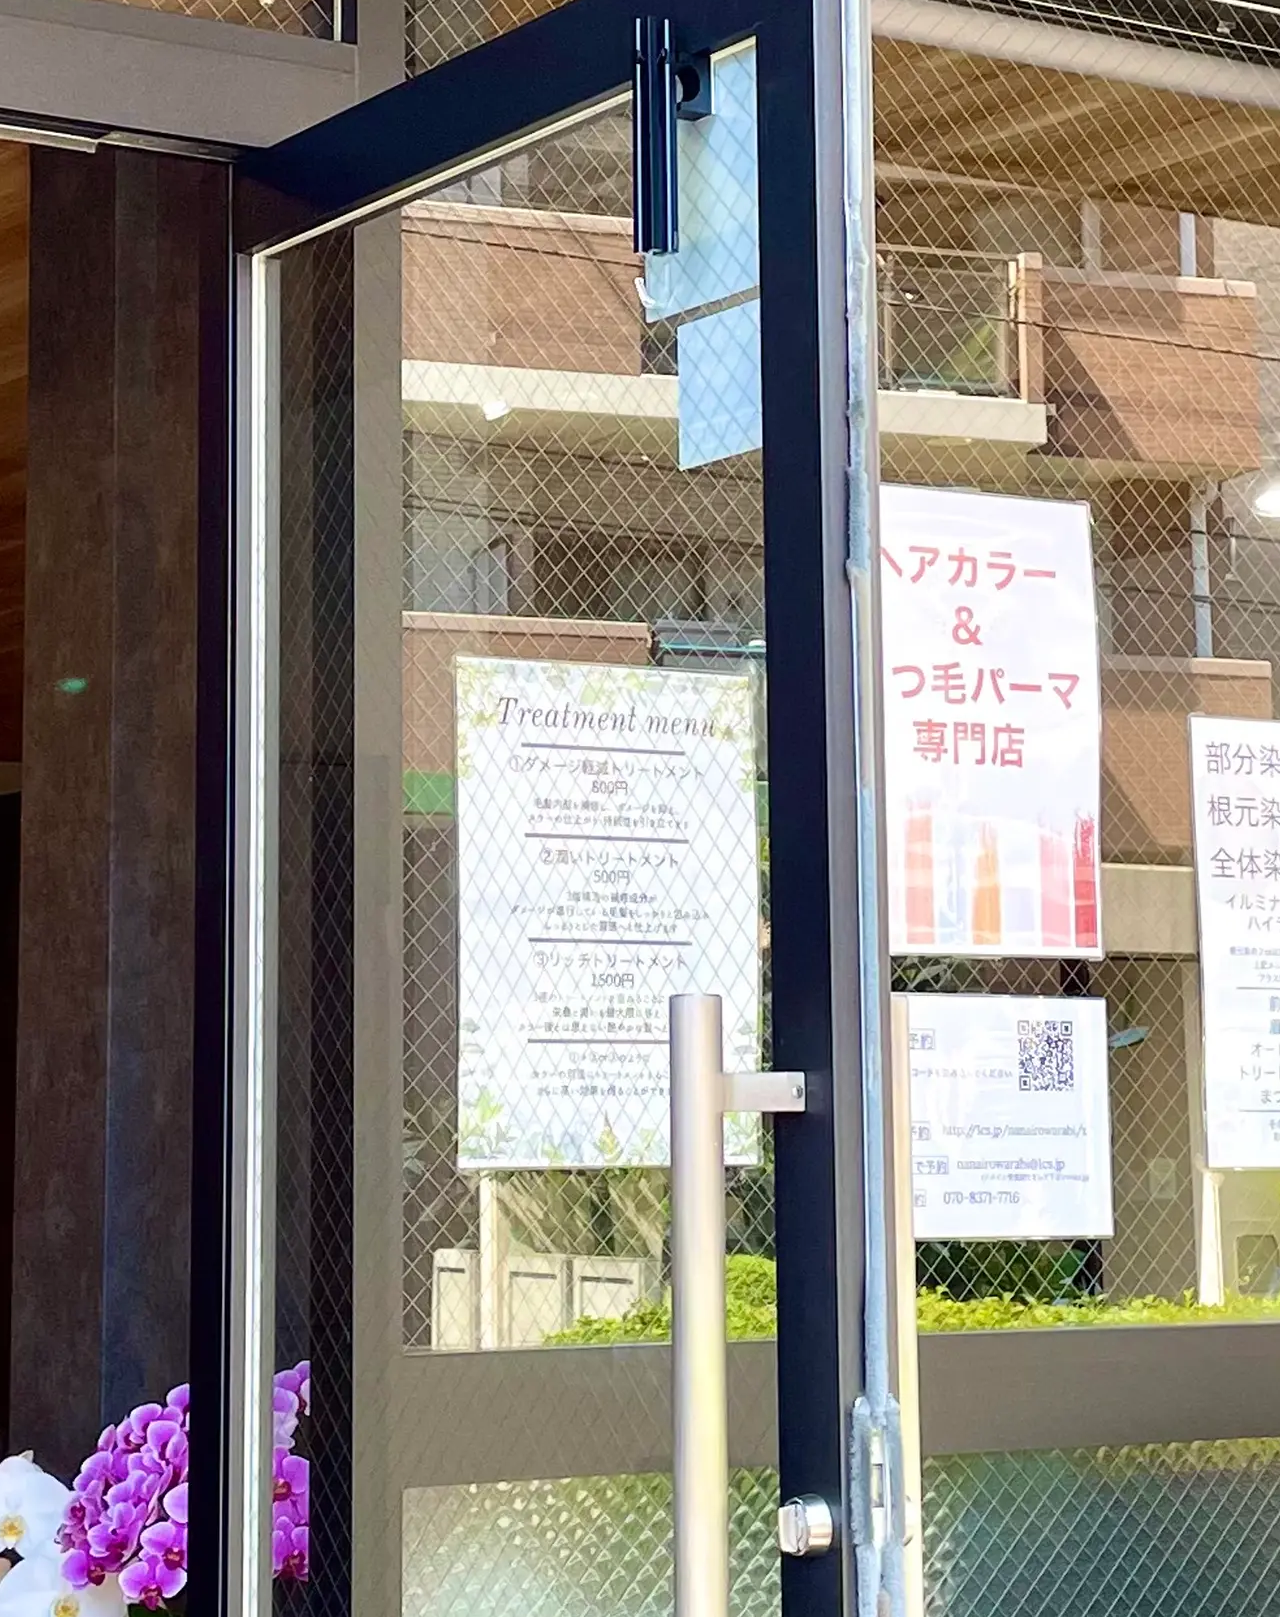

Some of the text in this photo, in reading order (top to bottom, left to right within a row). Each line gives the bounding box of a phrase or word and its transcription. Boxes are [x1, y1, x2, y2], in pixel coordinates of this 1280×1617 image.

[880, 545, 1056, 591] ヘアカラー
[952, 605, 983, 646] &
[892, 662, 1080, 710] つ毛パーマ
[497, 696, 716, 738] Treatment menu
[913, 718, 1025, 768] 専門店
